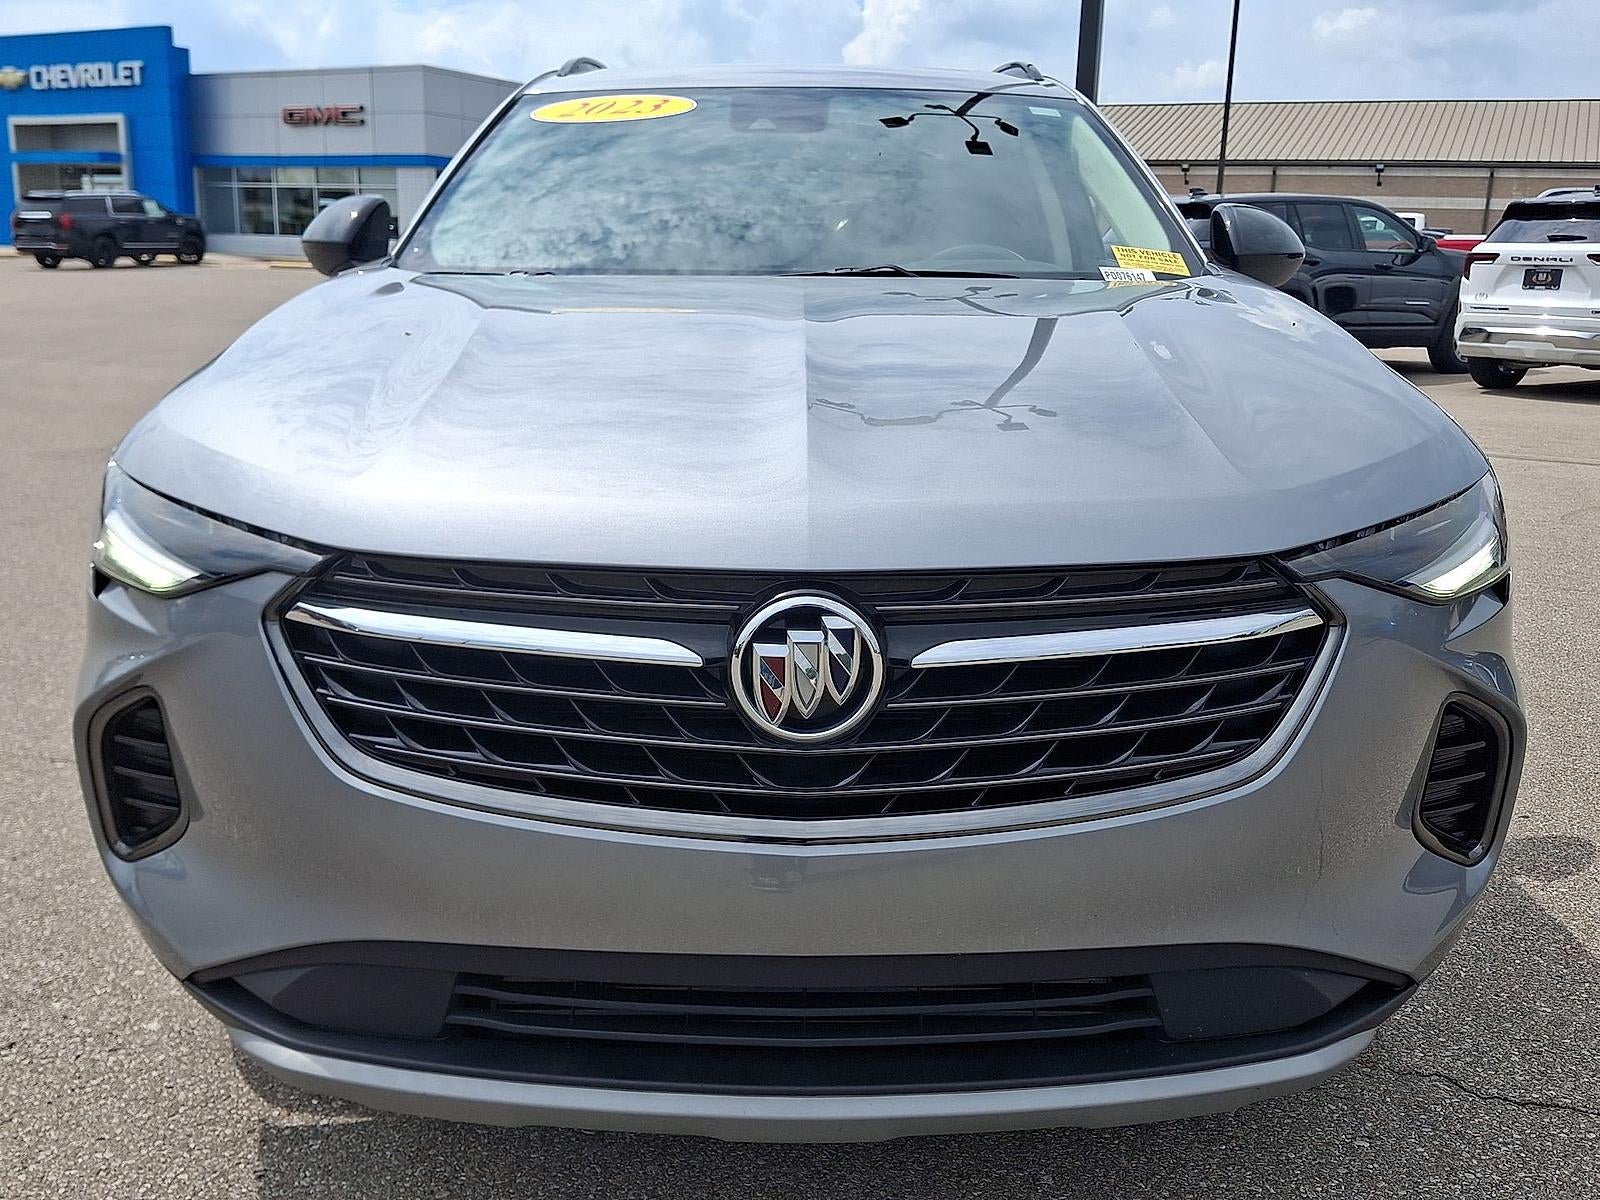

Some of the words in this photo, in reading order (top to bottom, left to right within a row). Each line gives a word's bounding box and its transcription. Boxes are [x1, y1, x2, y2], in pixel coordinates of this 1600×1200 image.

[29, 60, 144, 90] CHEVROLET
[283, 104, 365, 127] GMC
[555, 98, 670, 119] 2023
[1114, 246, 1137, 254] THIS
[1138, 249, 1180, 260] VEHICLE
